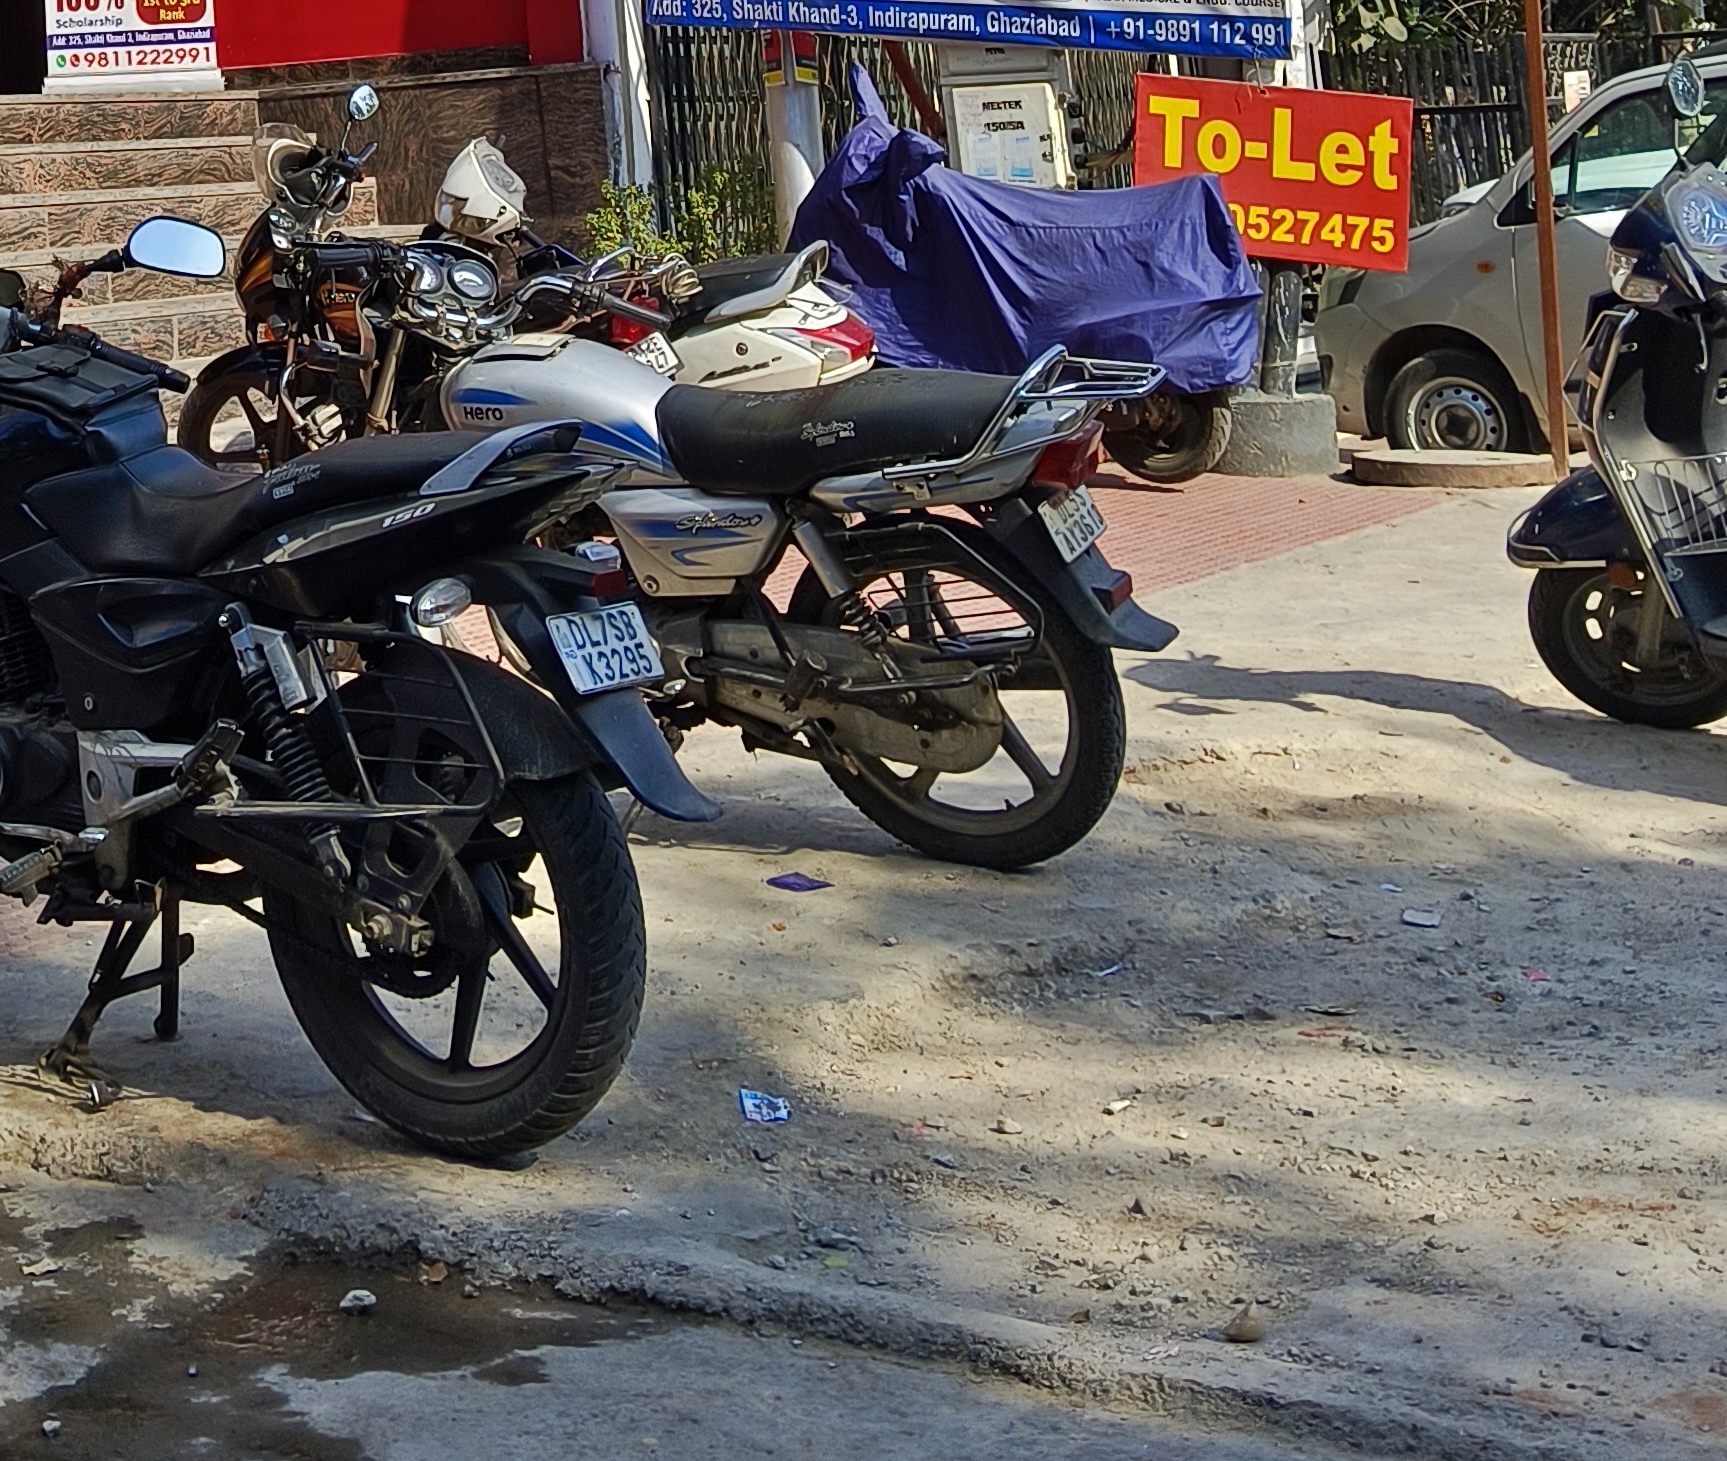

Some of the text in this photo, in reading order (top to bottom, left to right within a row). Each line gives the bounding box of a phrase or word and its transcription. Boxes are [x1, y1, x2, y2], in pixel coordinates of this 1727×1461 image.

[56, 17, 123, 28] Scholarship
[159, 7, 185, 20] Rank
[733, 0, 783, 22] Shakti
[788, 2, 863, 30] Khand-3,
[869, 5, 980, 34] Indirapuram,
[987, 12, 1079, 37] Ghaziabad
[1106, 18, 1200, 43] +91-9891
[1209, 21, 1245, 44] 112
[1252, 23, 1285, 46] 991
[84, 47, 210, 67] 9811222991
[1149, 95, 1399, 191] To-Let
[463, 405, 504, 422] Hero
[382, 502, 436, 530] 150
[566, 610, 638, 652] DL7SB
[582, 642, 653, 686] K3295
